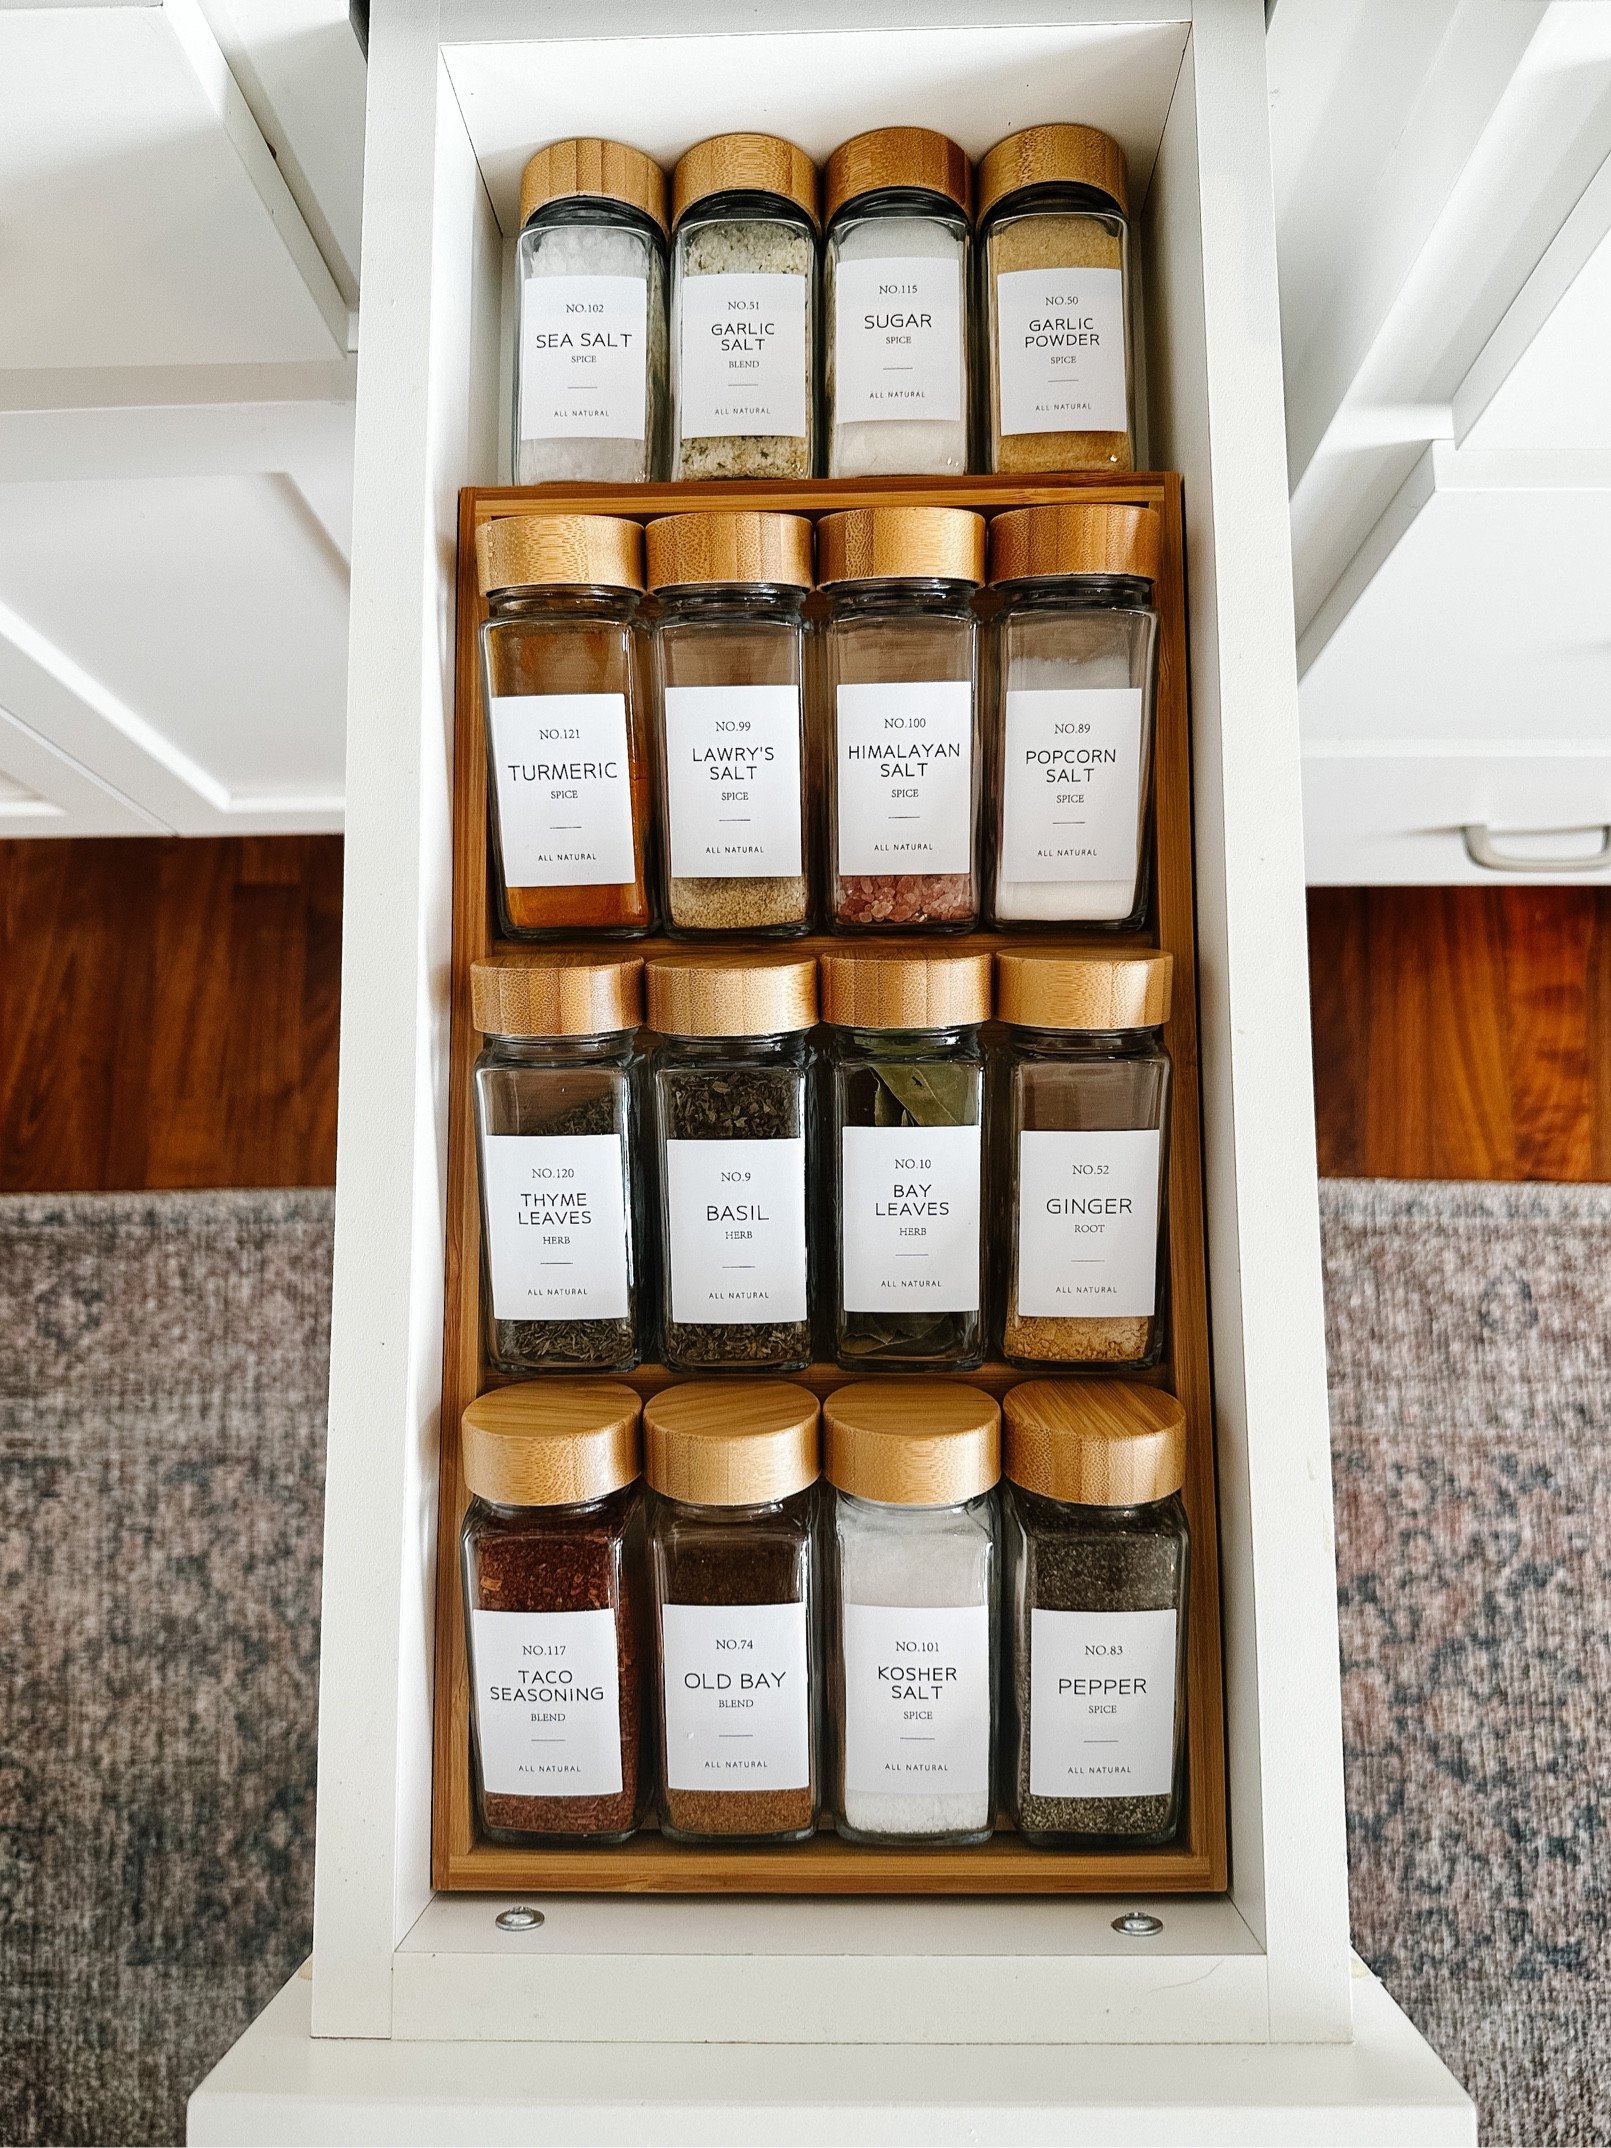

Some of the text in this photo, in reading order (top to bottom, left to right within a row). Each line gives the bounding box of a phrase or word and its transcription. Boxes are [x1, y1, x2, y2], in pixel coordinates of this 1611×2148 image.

[879, 284, 918, 295] NO.115
[727, 301, 759, 311] NO.51
[1045, 296, 1079, 306] NO.50
[566, 303, 604, 314] NO.102
[864, 313, 932, 330] SUGAR
[1028, 317, 1094, 333] GARLIC
[711, 322, 775, 336] GARLIC
[536, 332, 633, 349] SEA SALT
[721, 338, 766, 352] SALT
[885, 335, 912, 345] SPICE
[1024, 333, 1100, 349] POWDER
[571, 355, 597, 364] SPICE
[728, 360, 760, 369] BLEND
[1050, 355, 1077, 365] SPICE
[714, 407, 769, 416] ALL NATURAL
[1035, 402, 1091, 412] ALL NATURAL
[553, 409, 608, 418] ALL NATURAL
[715, 720, 752, 732] NO.99
[884, 717, 927, 729] NO.100
[538, 728, 580, 740] NO.121
[1054, 723, 1091, 735] NO.89
[692, 746, 775, 762] LAWRY'S
[848, 743, 960, 760] HIMALAYAN
[1025, 748, 1116, 765] POPCORN
[507, 761, 618, 782] TURMERIC
[709, 765, 758, 781] SALT
[880, 762, 929, 778] SALT
[1045, 767, 1095, 783] SALT
[550, 789, 579, 800] SPICE
[721, 791, 749, 801] SPICE
[891, 788, 919, 799] SPICE
[1056, 794, 1085, 804] SPICE
[705, 846, 764, 854] ALL NATURAL
[873, 843, 933, 852] ALL NATURAL
[1037, 848, 1097, 857] ALL NATURAL
[538, 853, 597, 862] ALL NATURAL
[894, 1158, 932, 1170] NO.10
[1072, 1164, 1109, 1175] NO.52
[531, 1167, 575, 1179] NO.120
[720, 1171, 751, 1182] NO.9
[893, 1183, 932, 1198] BAY
[520, 1192, 587, 1208] THYME
[875, 1201, 950, 1217] LEAVES
[1046, 1198, 1133, 1215] GINGER
[518, 1210, 592, 1226] LEAVES
[706, 1204, 770, 1222] BASIL
[899, 1227, 927, 1236] HERB
[1074, 1224, 1106, 1234] ROOT
[542, 1236, 571, 1245] HERB
[725, 1230, 753, 1240] HERB
[880, 1280, 941, 1288] ALL NATURAL
[527, 1288, 588, 1296] ALL NATURAL
[708, 1291, 769, 1300] ALL NATURAL
[1055, 1286, 1117, 1294] ALL NATURAL
[715, 1639, 753, 1650] NO.74
[895, 1641, 939, 1653] NO.101
[522, 1645, 567, 1656] NO.117
[1084, 1645, 1124, 1656] NO.83
[517, 1669, 573, 1685] TACO
[877, 1665, 957, 1682] KOSHER
[684, 1671, 787, 1690] OLD BAY
[891, 1684, 943, 1700] SALT
[1058, 1678, 1147, 1696] PEPPER
[489, 1686, 604, 1703] SEASONING
[718, 1699, 754, 1709] BLEND
[1088, 1704, 1118, 1714] SPICE
[530, 1712, 566, 1722] BLEND
[903, 1710, 933, 1720] SPICE
[518, 1764, 580, 1773] ALL NATURAL
[704, 1760, 768, 1769] ALL NATURAL
[884, 1762, 948, 1772] ALL NATURAL
[1067, 1765, 1131, 1775] ALL NATURAL
